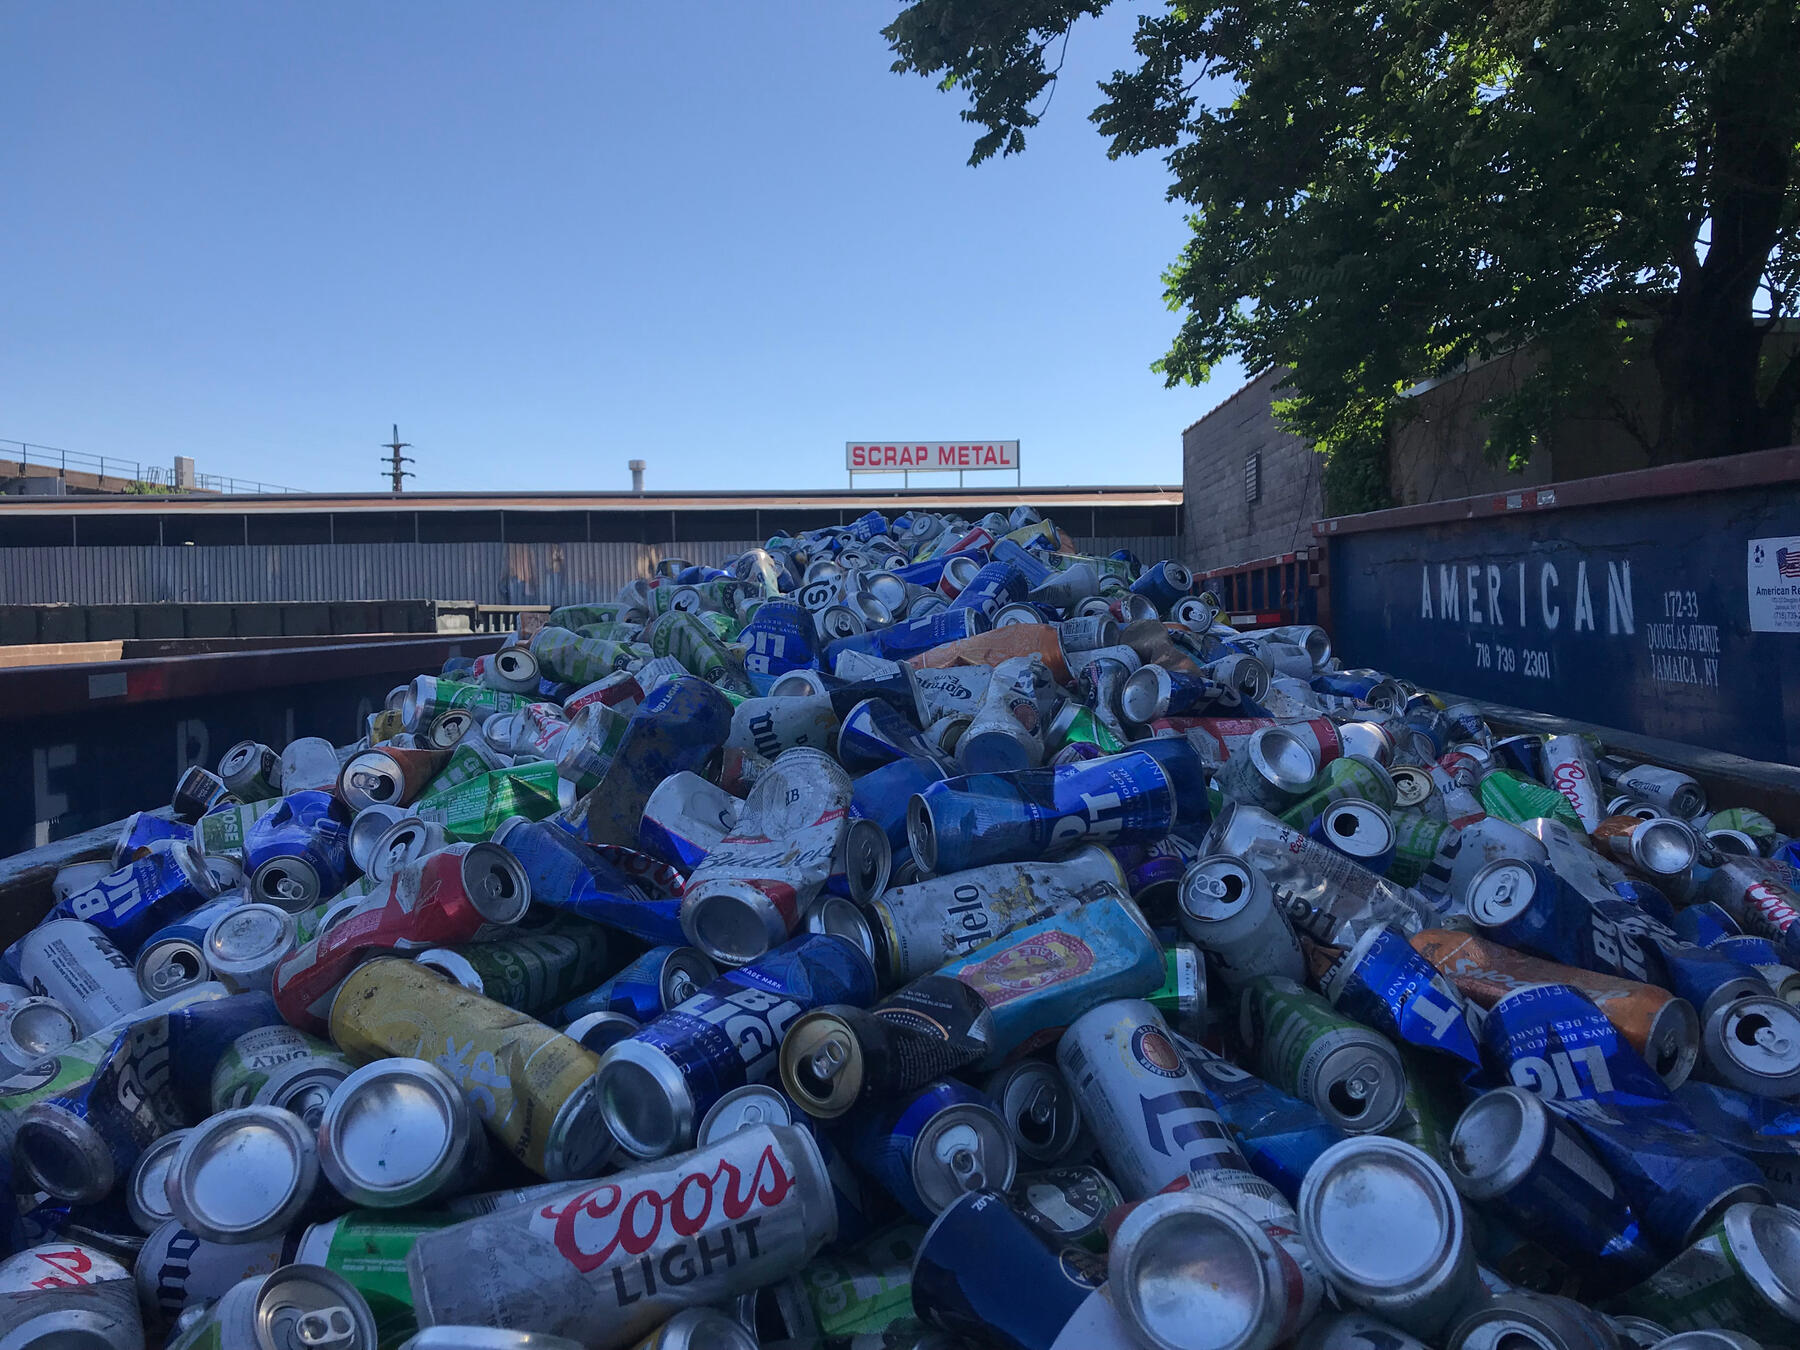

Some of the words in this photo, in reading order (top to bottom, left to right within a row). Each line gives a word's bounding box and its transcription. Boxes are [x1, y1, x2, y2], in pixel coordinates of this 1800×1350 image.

[852, 446, 928, 466] SCRAP
[938, 445, 1011, 466] METAL
[1421, 560, 1635, 635] AMERICAN
[1664, 590, 1699, 618] 172-33
[1756, 585, 1789, 596] American
[1646, 623, 1688, 650] DOUGLAS
[1689, 624, 1721, 654] AVENUE
[1474, 642, 1491, 668] 718
[1496, 644, 1516, 673] 739
[1523, 648, 1551, 679] 2301
[1704, 657, 1719, 688] NY
[1627, 777, 1661, 794] Corona
[946, 884, 992, 950] delo
[761, 976, 783, 990] MARK
[1387, 972, 1407, 998] AND
[723, 986, 802, 1047] BU
[1510, 1045, 1617, 1101] LIG
[540, 1144, 797, 1274] Coors
[612, 1216, 763, 1308] LIGHT
